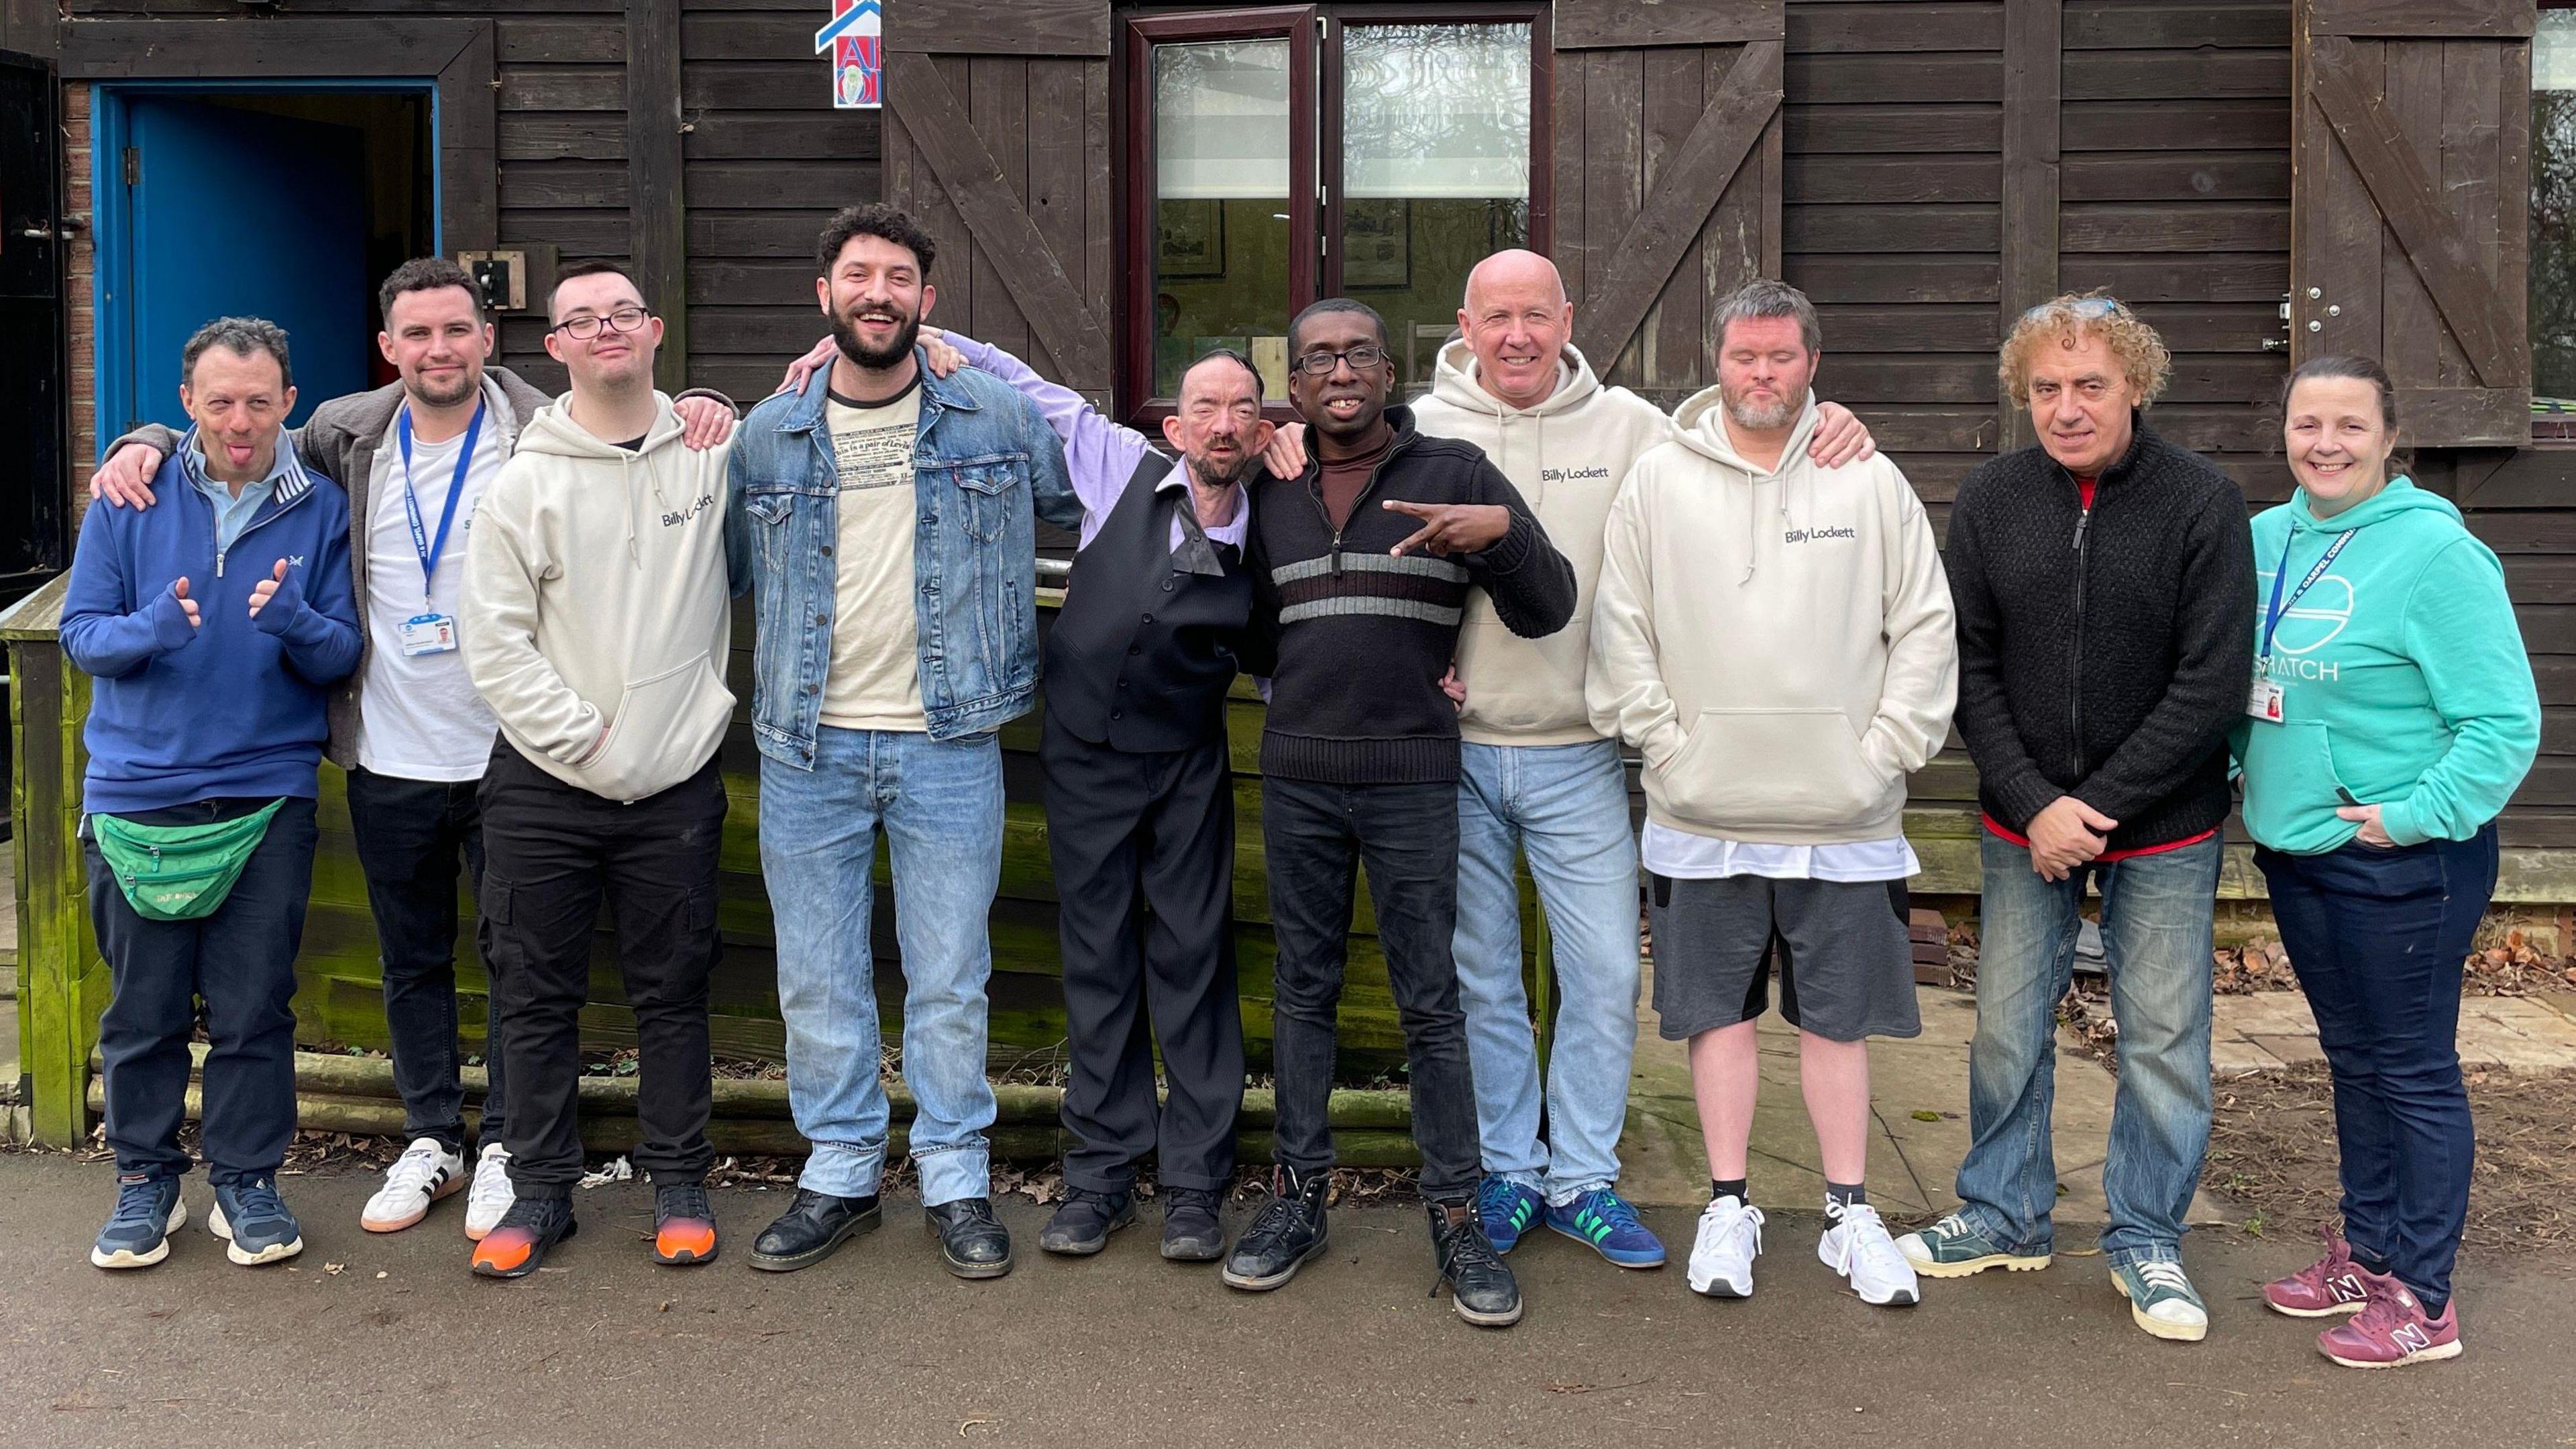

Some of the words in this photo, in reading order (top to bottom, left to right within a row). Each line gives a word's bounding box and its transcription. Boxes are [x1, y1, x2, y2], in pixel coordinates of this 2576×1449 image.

[1542, 468, 1566, 483] Billy
[1567, 466, 1609, 479] Lockett
[661, 511, 684, 527] Billy
[685, 494, 713, 520] Lcktt
[1785, 529, 1809, 543] Billy
[1811, 525, 1855, 539] Lockett
